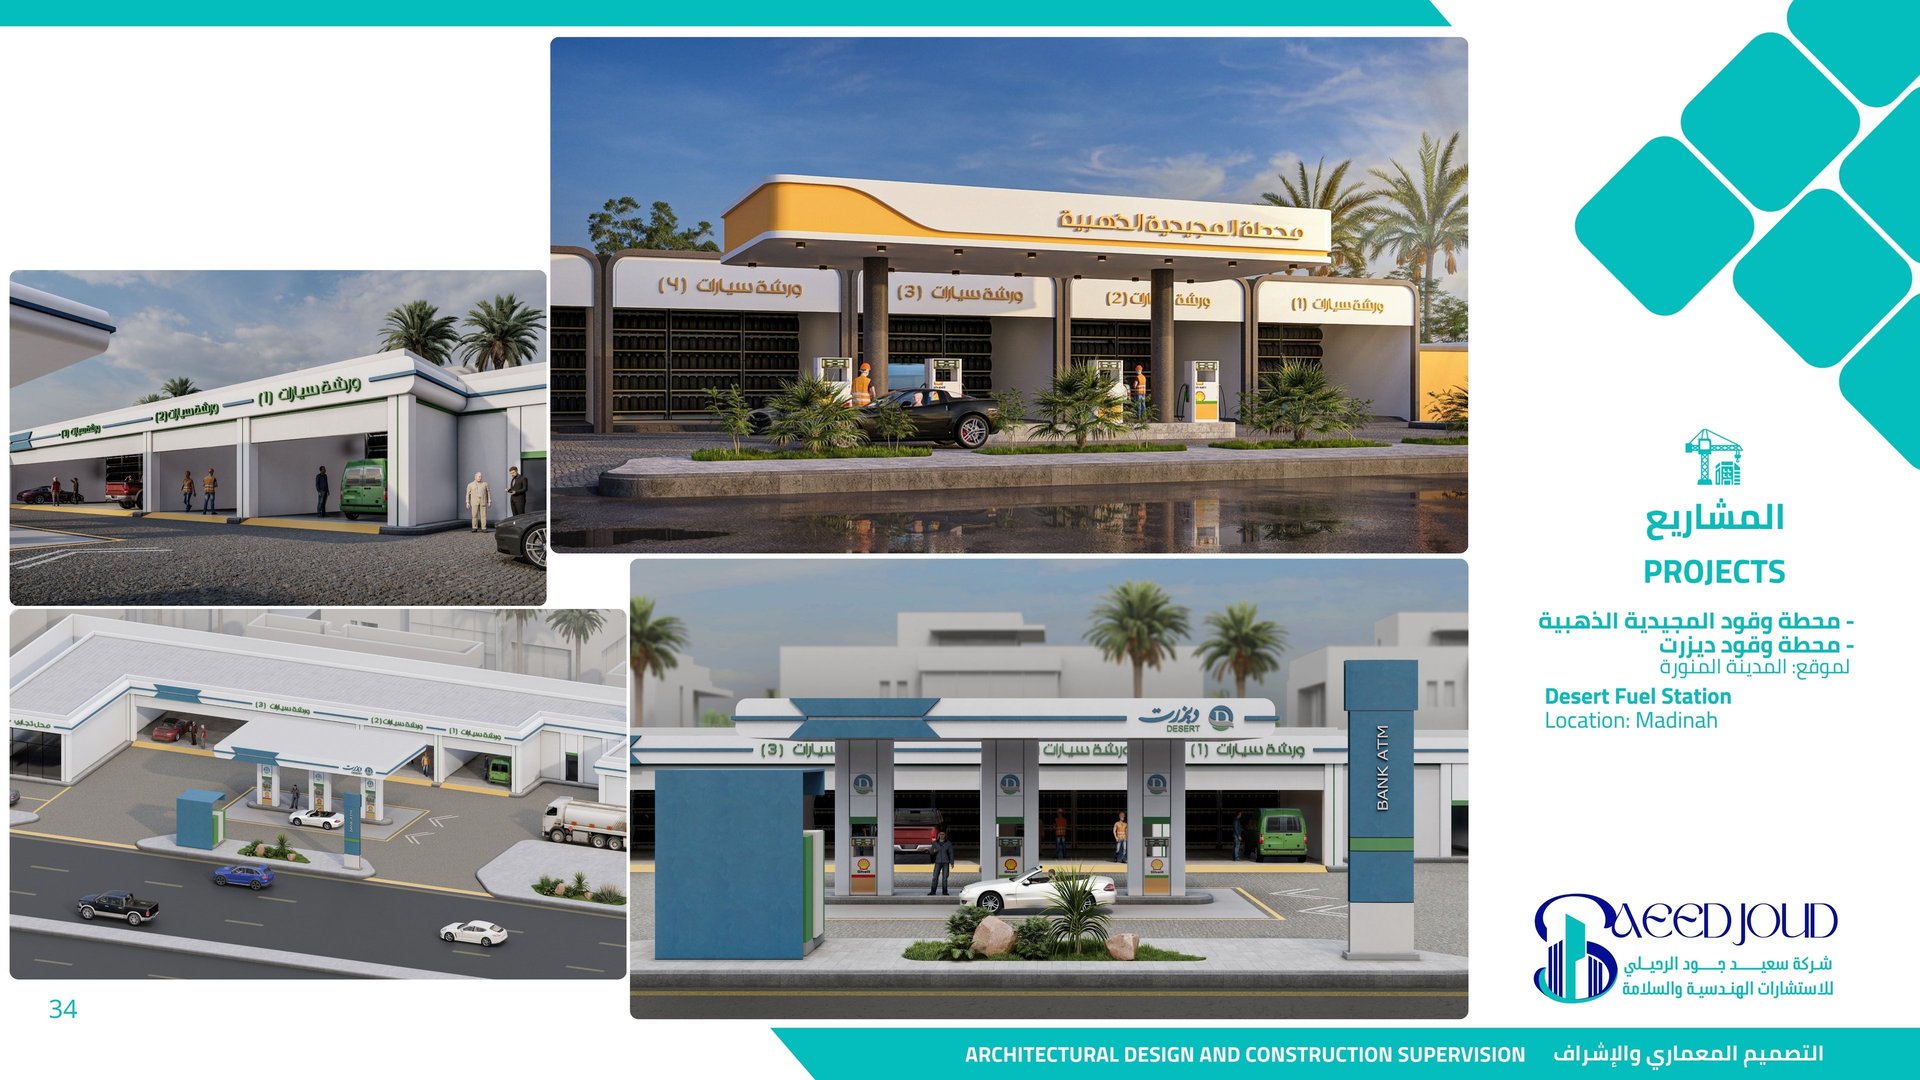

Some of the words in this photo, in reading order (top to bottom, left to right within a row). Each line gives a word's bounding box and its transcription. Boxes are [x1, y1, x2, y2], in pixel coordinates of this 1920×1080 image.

[1057, 208, 1146, 234] الذهبية
[1144, 213, 1239, 239] المجيدية
[1240, 219, 1304, 242] محطة
[696, 278, 754, 296] سيارات
[755, 278, 803, 298] ورشة
[897, 280, 922, 301] (3)
[930, 285, 981, 302] سيارات
[982, 286, 1024, 304] ورشة
[1105, 291, 1128, 307] (2)
[1129, 292, 1151, 308] ارات
[1175, 293, 1211, 310] ورشة
[1291, 297, 1308, 312] (1)
[1312, 298, 1352, 313] سيارات
[1352, 298, 1385, 314] ورشة
[278, 384, 321, 403] سيارات
[321, 376, 362, 394] ورشة
[258, 390, 274, 407] (1)
[155, 410, 168, 424] (2)
[168, 407, 196, 421] سيارات
[194, 401, 220, 416] ورشة
[255, 701, 267, 709] (3)
[371, 717, 383, 725] (2)
[1138, 706, 1200, 724] ديزرت
[449, 727, 459, 735] (1)
[1166, 725, 1200, 733] DESERT
[761, 743, 784, 758] (3)
[1043, 742, 1090, 759] سيارات
[1191, 743, 1209, 759] (1)
[1216, 743, 1264, 759] سيارات
[1265, 742, 1306, 759] ورشة
[1376, 725, 1389, 761] ATM
[1376, 765, 1389, 812] BANK
